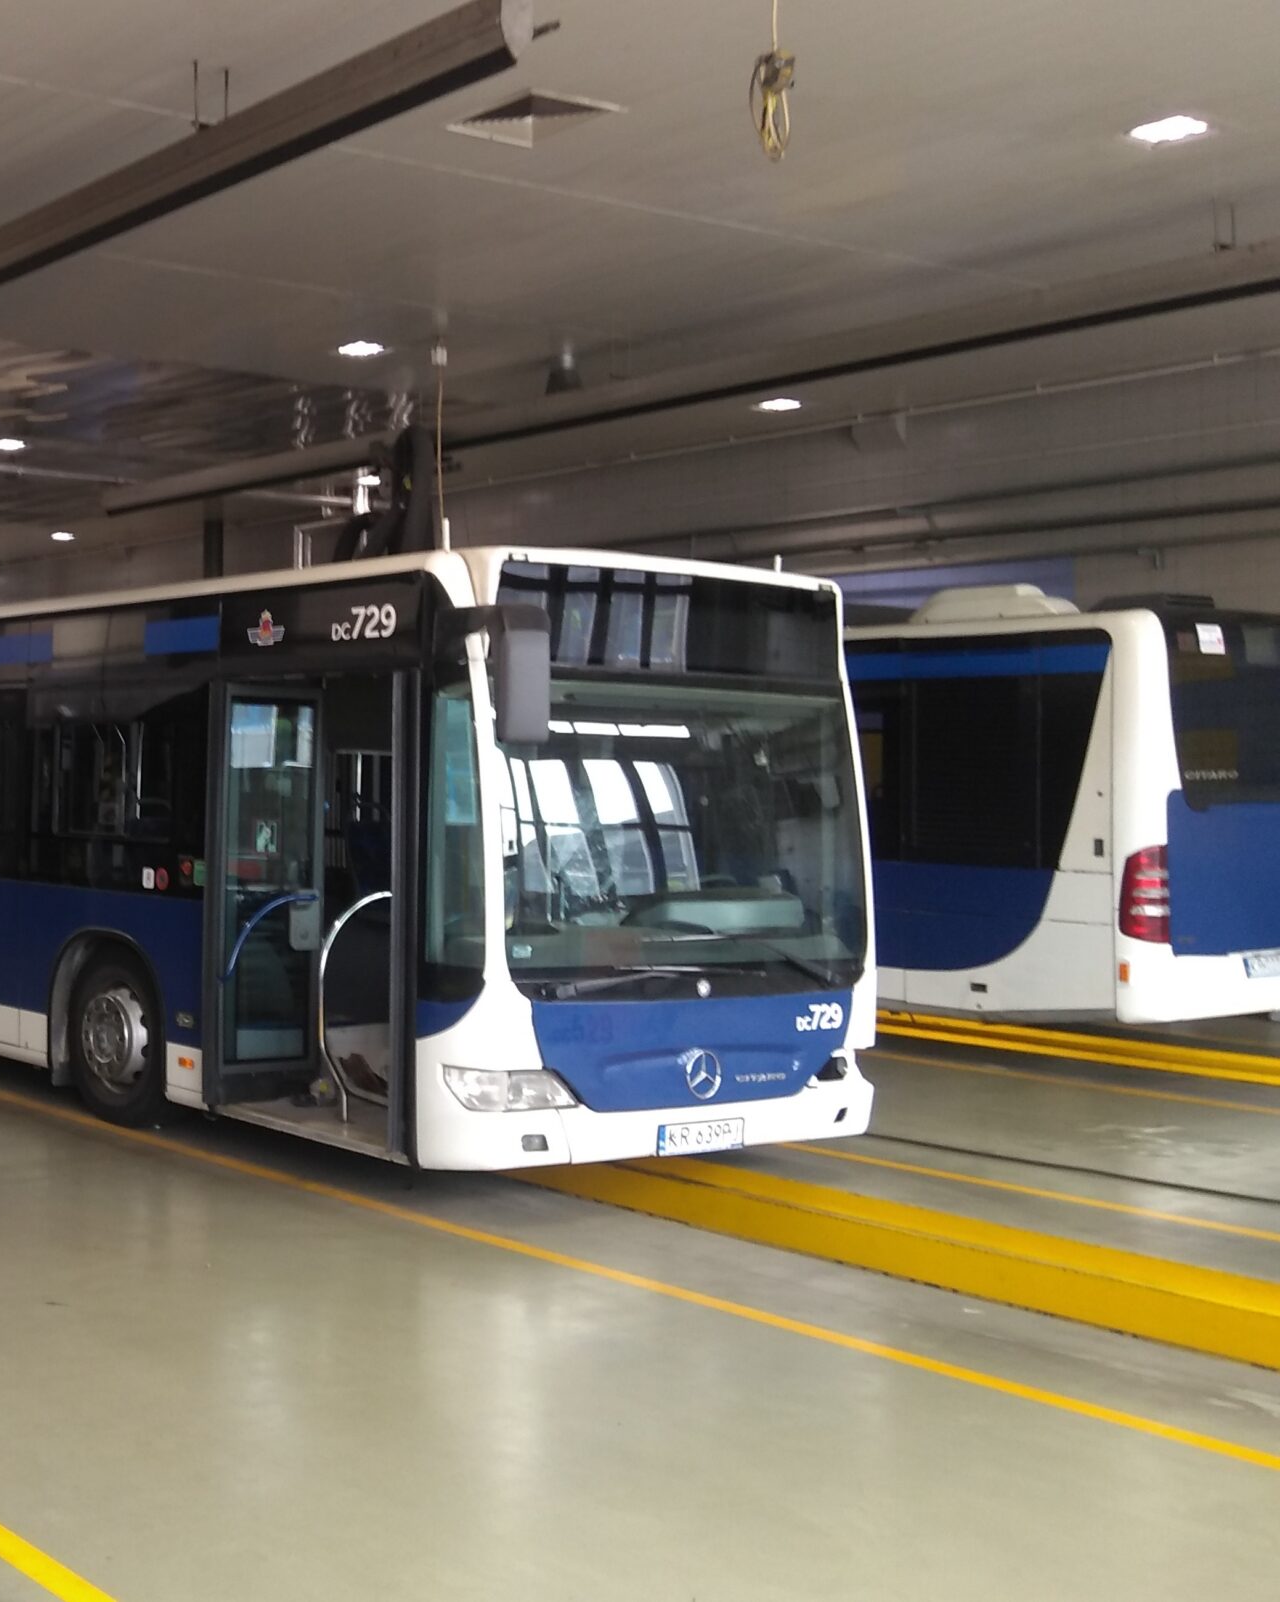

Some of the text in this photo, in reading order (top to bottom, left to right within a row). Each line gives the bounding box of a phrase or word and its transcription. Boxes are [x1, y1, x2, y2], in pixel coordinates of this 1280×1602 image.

[331, 603, 397, 642] DC729
[795, 1002, 844, 1032] DC729
[668, 1126, 690, 1147] KR
